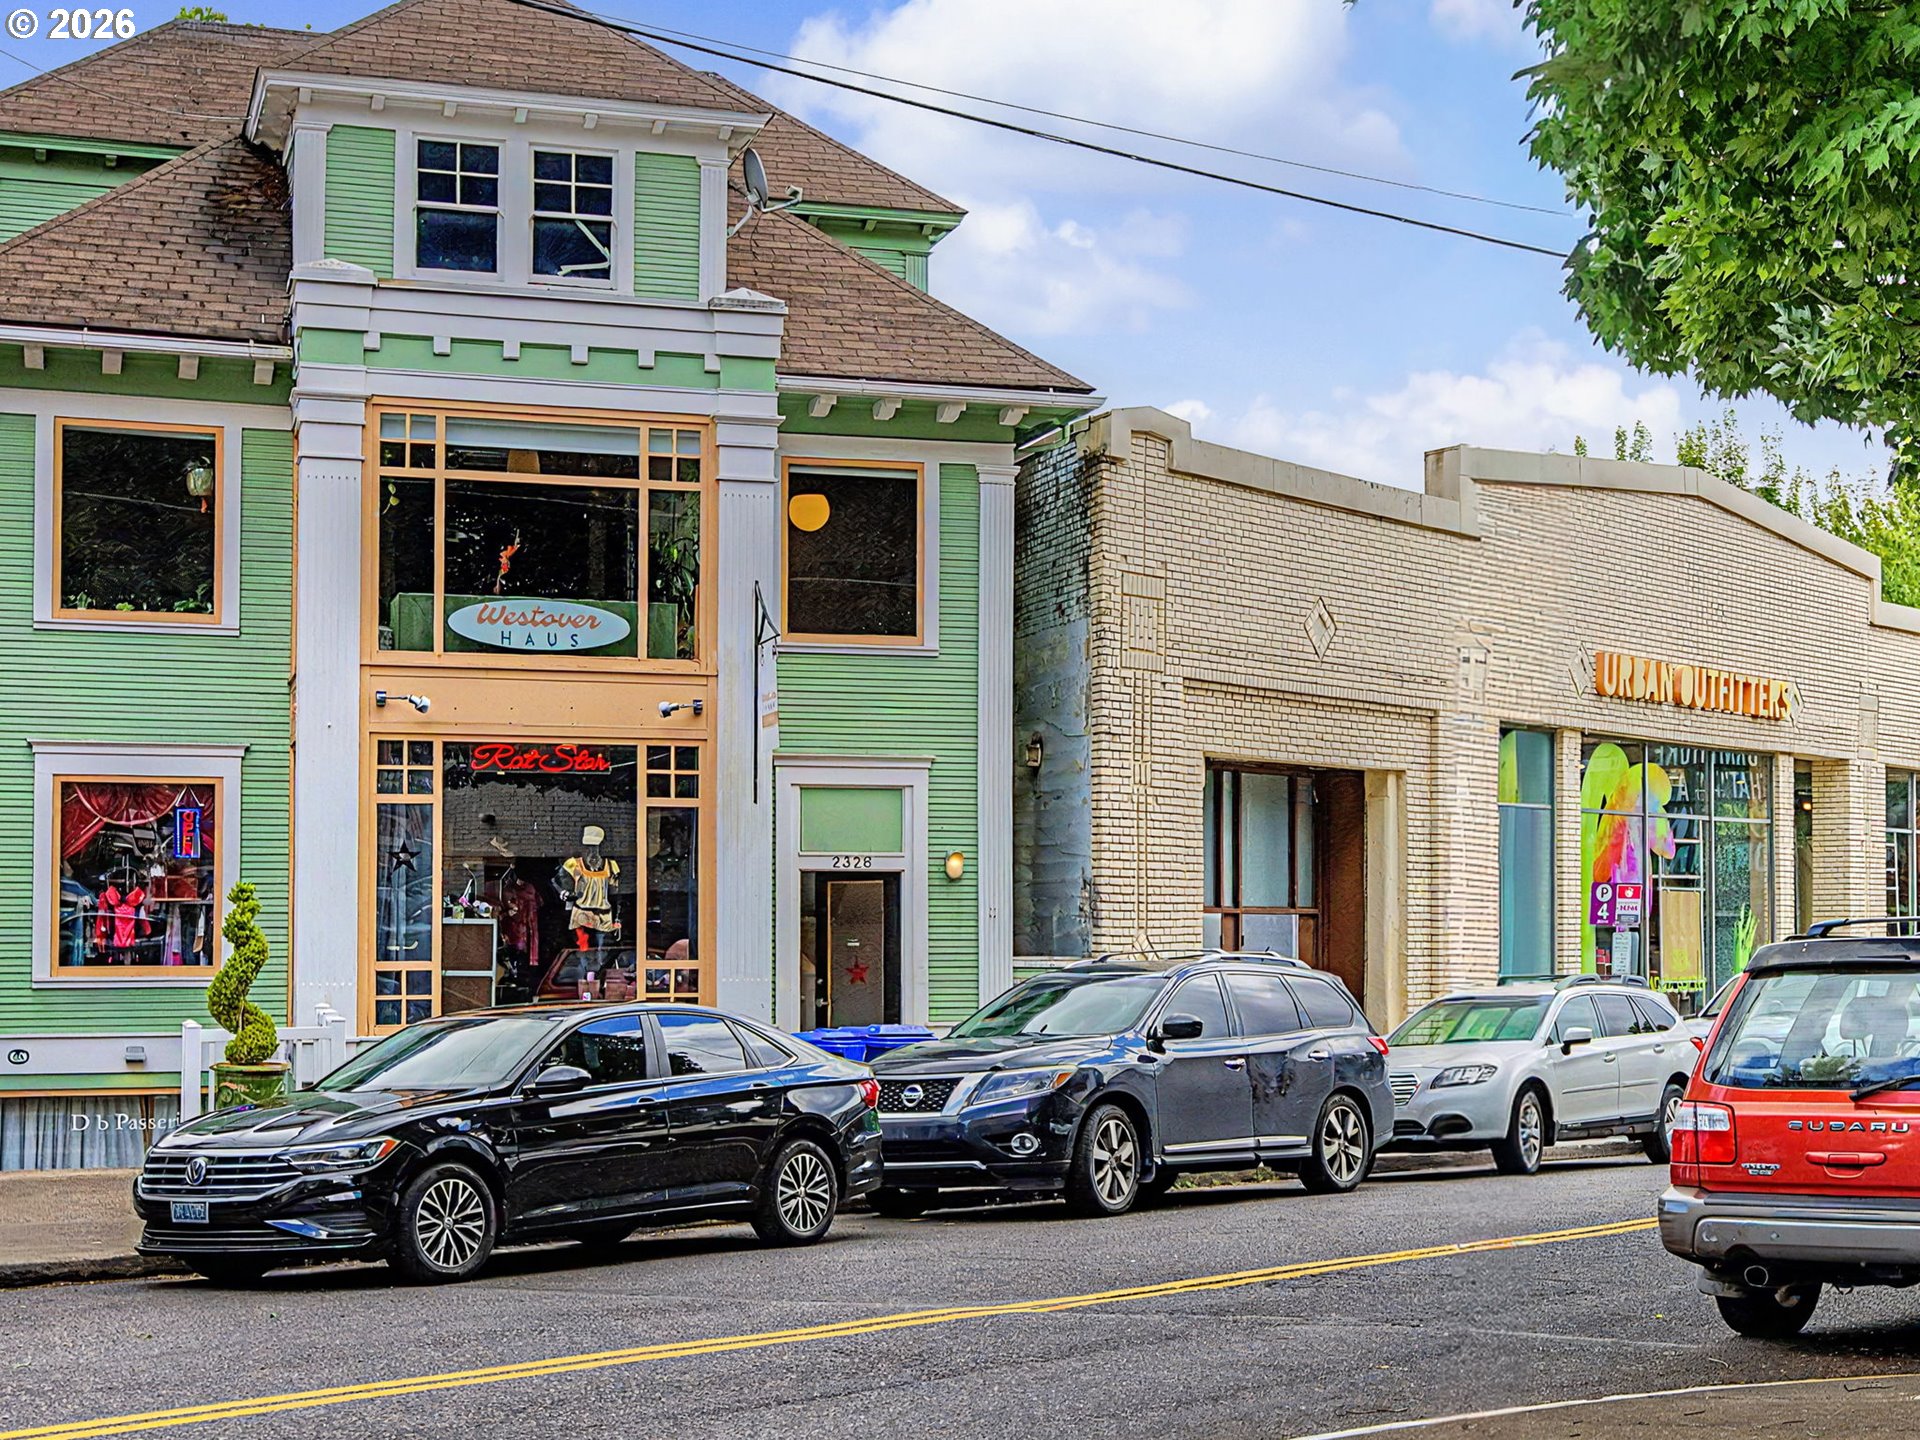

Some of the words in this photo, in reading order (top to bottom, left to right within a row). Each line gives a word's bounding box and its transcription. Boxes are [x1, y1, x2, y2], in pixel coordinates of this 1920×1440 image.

[477, 604, 601, 630] Westover
[501, 630, 579, 647] HAUS
[1595, 651, 1673, 703] URBAN
[1674, 664, 1792, 722] OUTFITTERS
[471, 743, 540, 770] Rat
[539, 743, 612, 773] Star
[1600, 886, 1609, 898] P
[1597, 902, 1610, 920] 4
[71, 1113, 91, 1131] D
[1788, 1120, 1910, 1133] SUBARU
